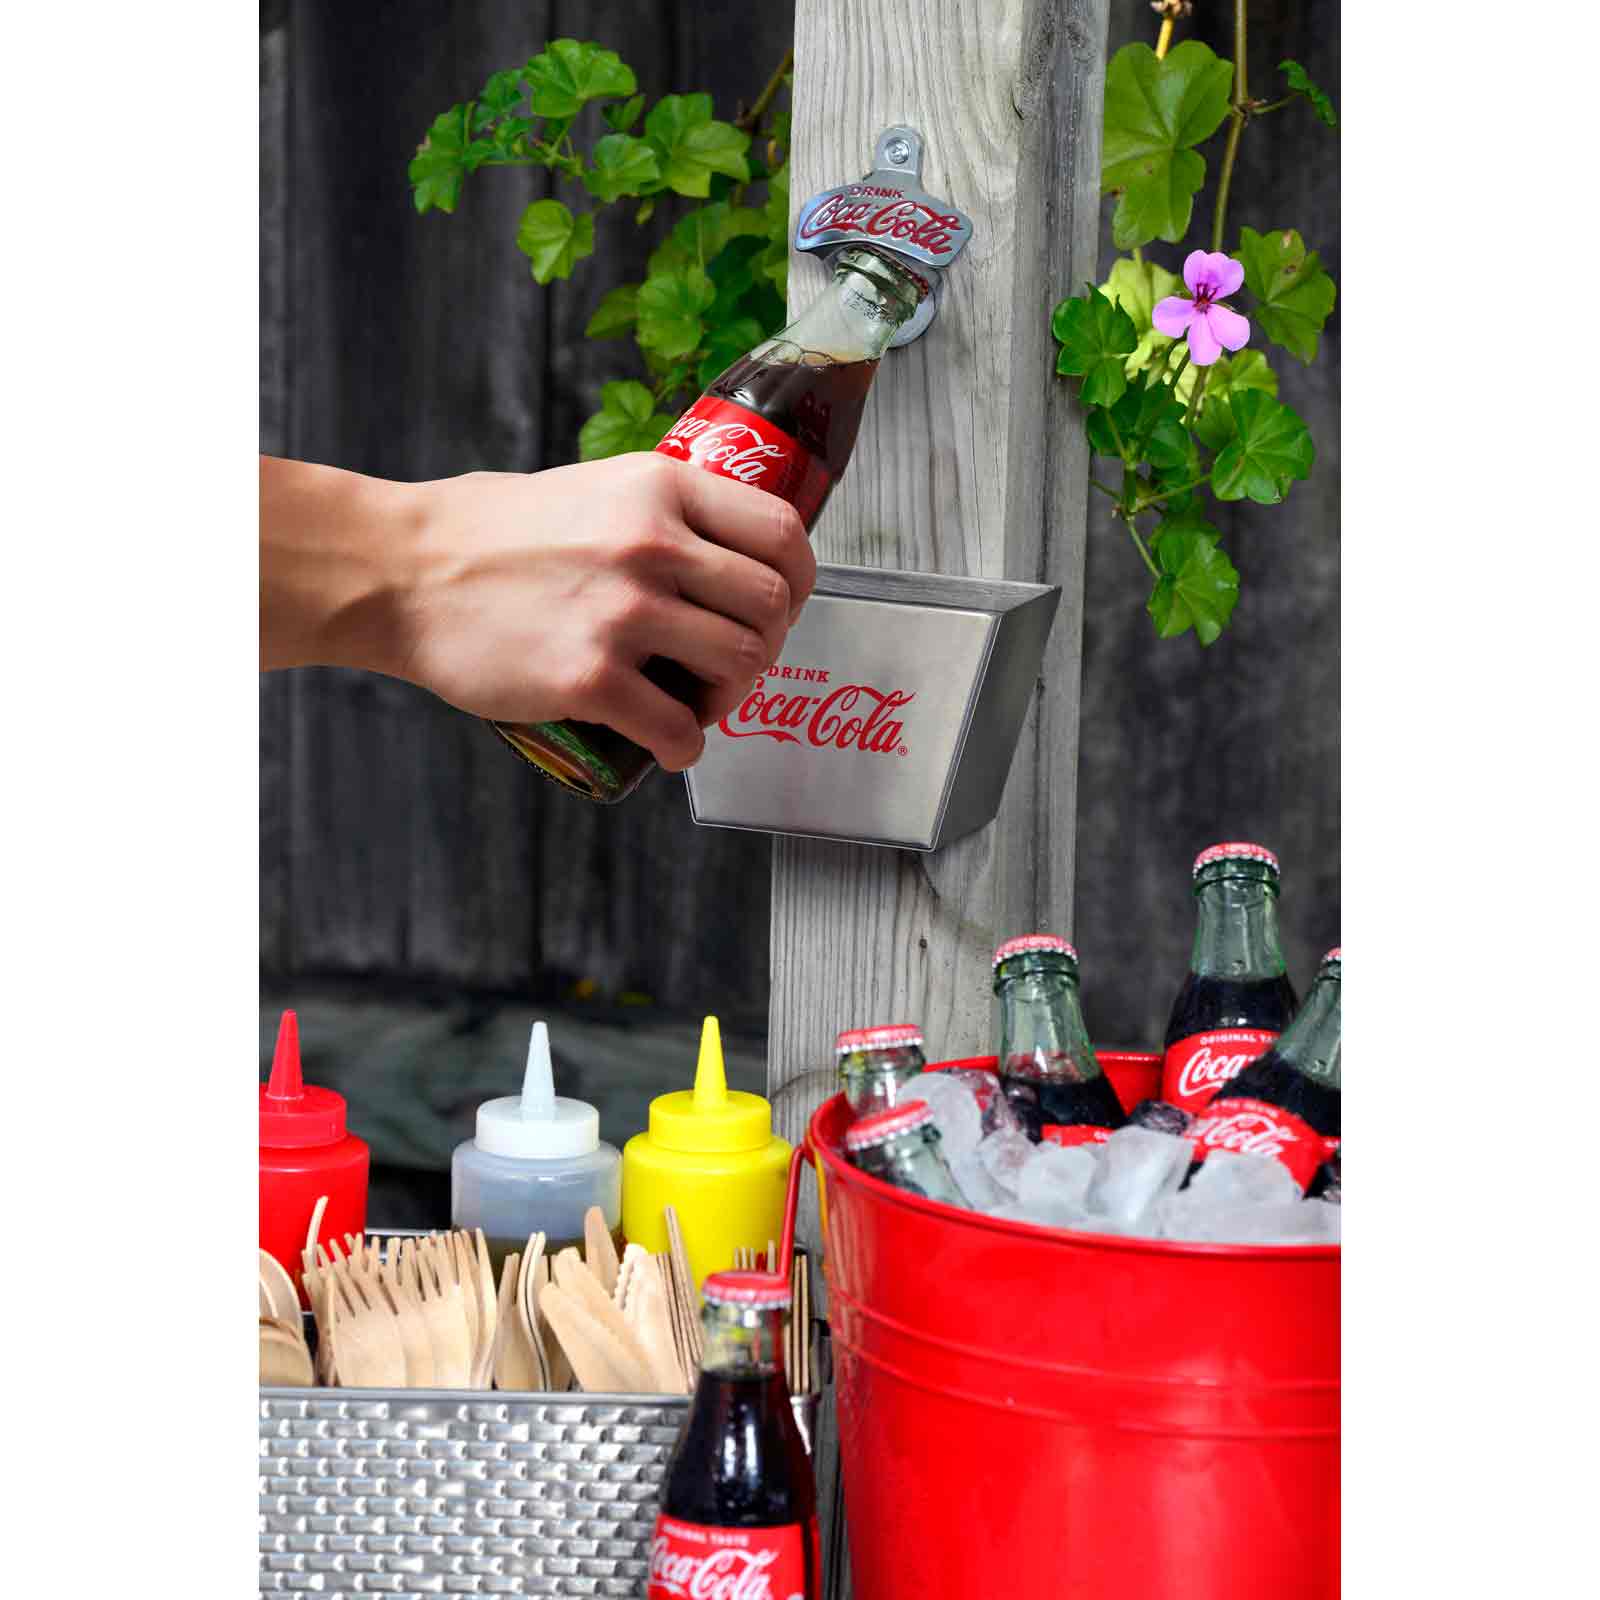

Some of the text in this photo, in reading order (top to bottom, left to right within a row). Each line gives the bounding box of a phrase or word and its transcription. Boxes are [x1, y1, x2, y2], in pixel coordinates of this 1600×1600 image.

[849, 185, 904, 199] DRINK
[801, 194, 964, 255] Coca-Cola
[767, 665, 830, 683] DRINK
[1200, 1033, 1257, 1046] ORIGINAL
[1178, 1047, 1256, 1097] Coca-
